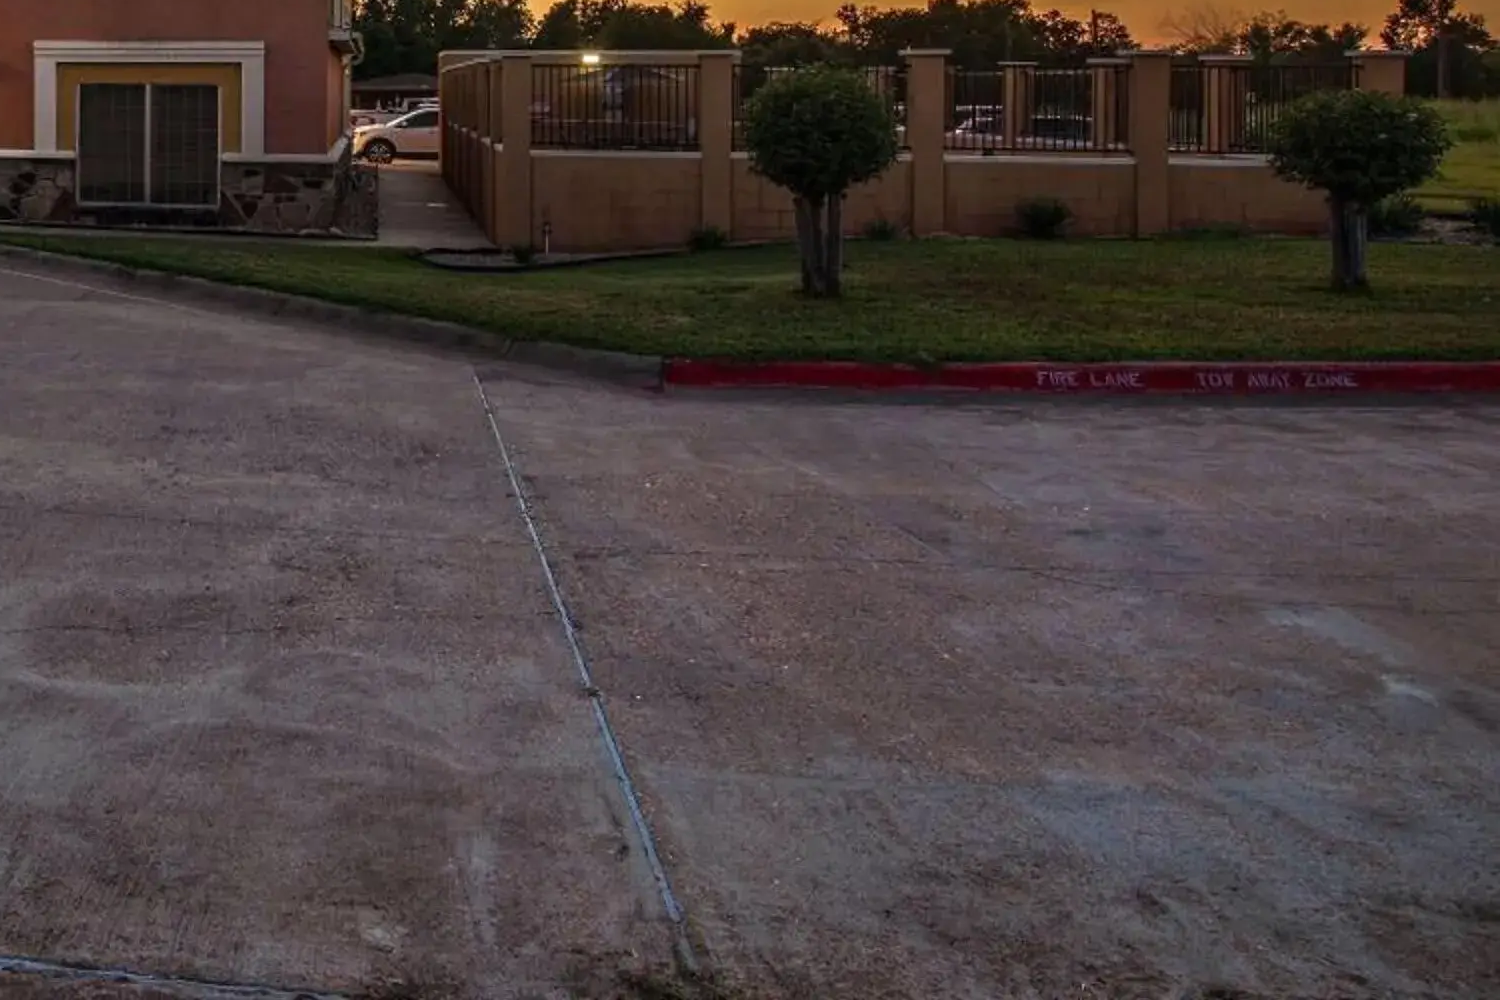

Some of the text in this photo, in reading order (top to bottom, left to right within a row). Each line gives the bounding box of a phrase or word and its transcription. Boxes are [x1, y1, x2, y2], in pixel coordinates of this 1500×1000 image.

[1037, 370, 1145, 388] FIRE LANE
[1303, 372, 1359, 388] ZONE
